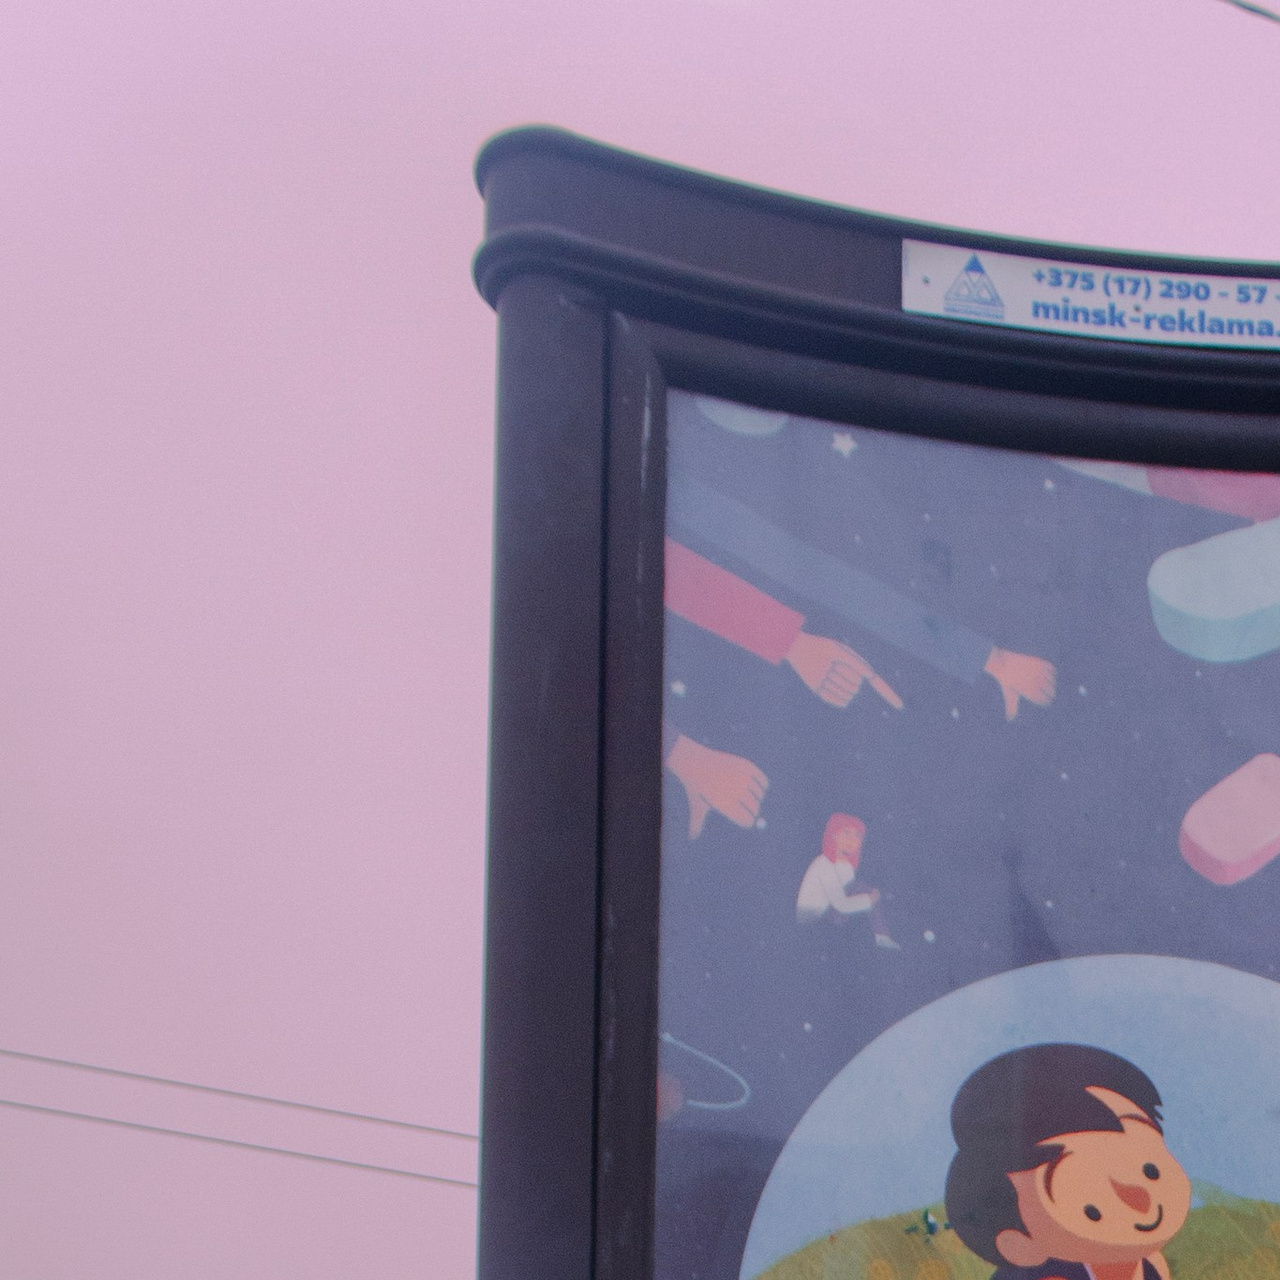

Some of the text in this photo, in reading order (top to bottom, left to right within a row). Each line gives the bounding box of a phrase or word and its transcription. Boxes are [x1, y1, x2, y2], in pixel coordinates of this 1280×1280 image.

[1032, 266, 1095, 291] +375
[1103, 271, 1151, 301] (17)
[1159, 277, 1211, 301] 290
[1237, 283, 1267, 304] 57
